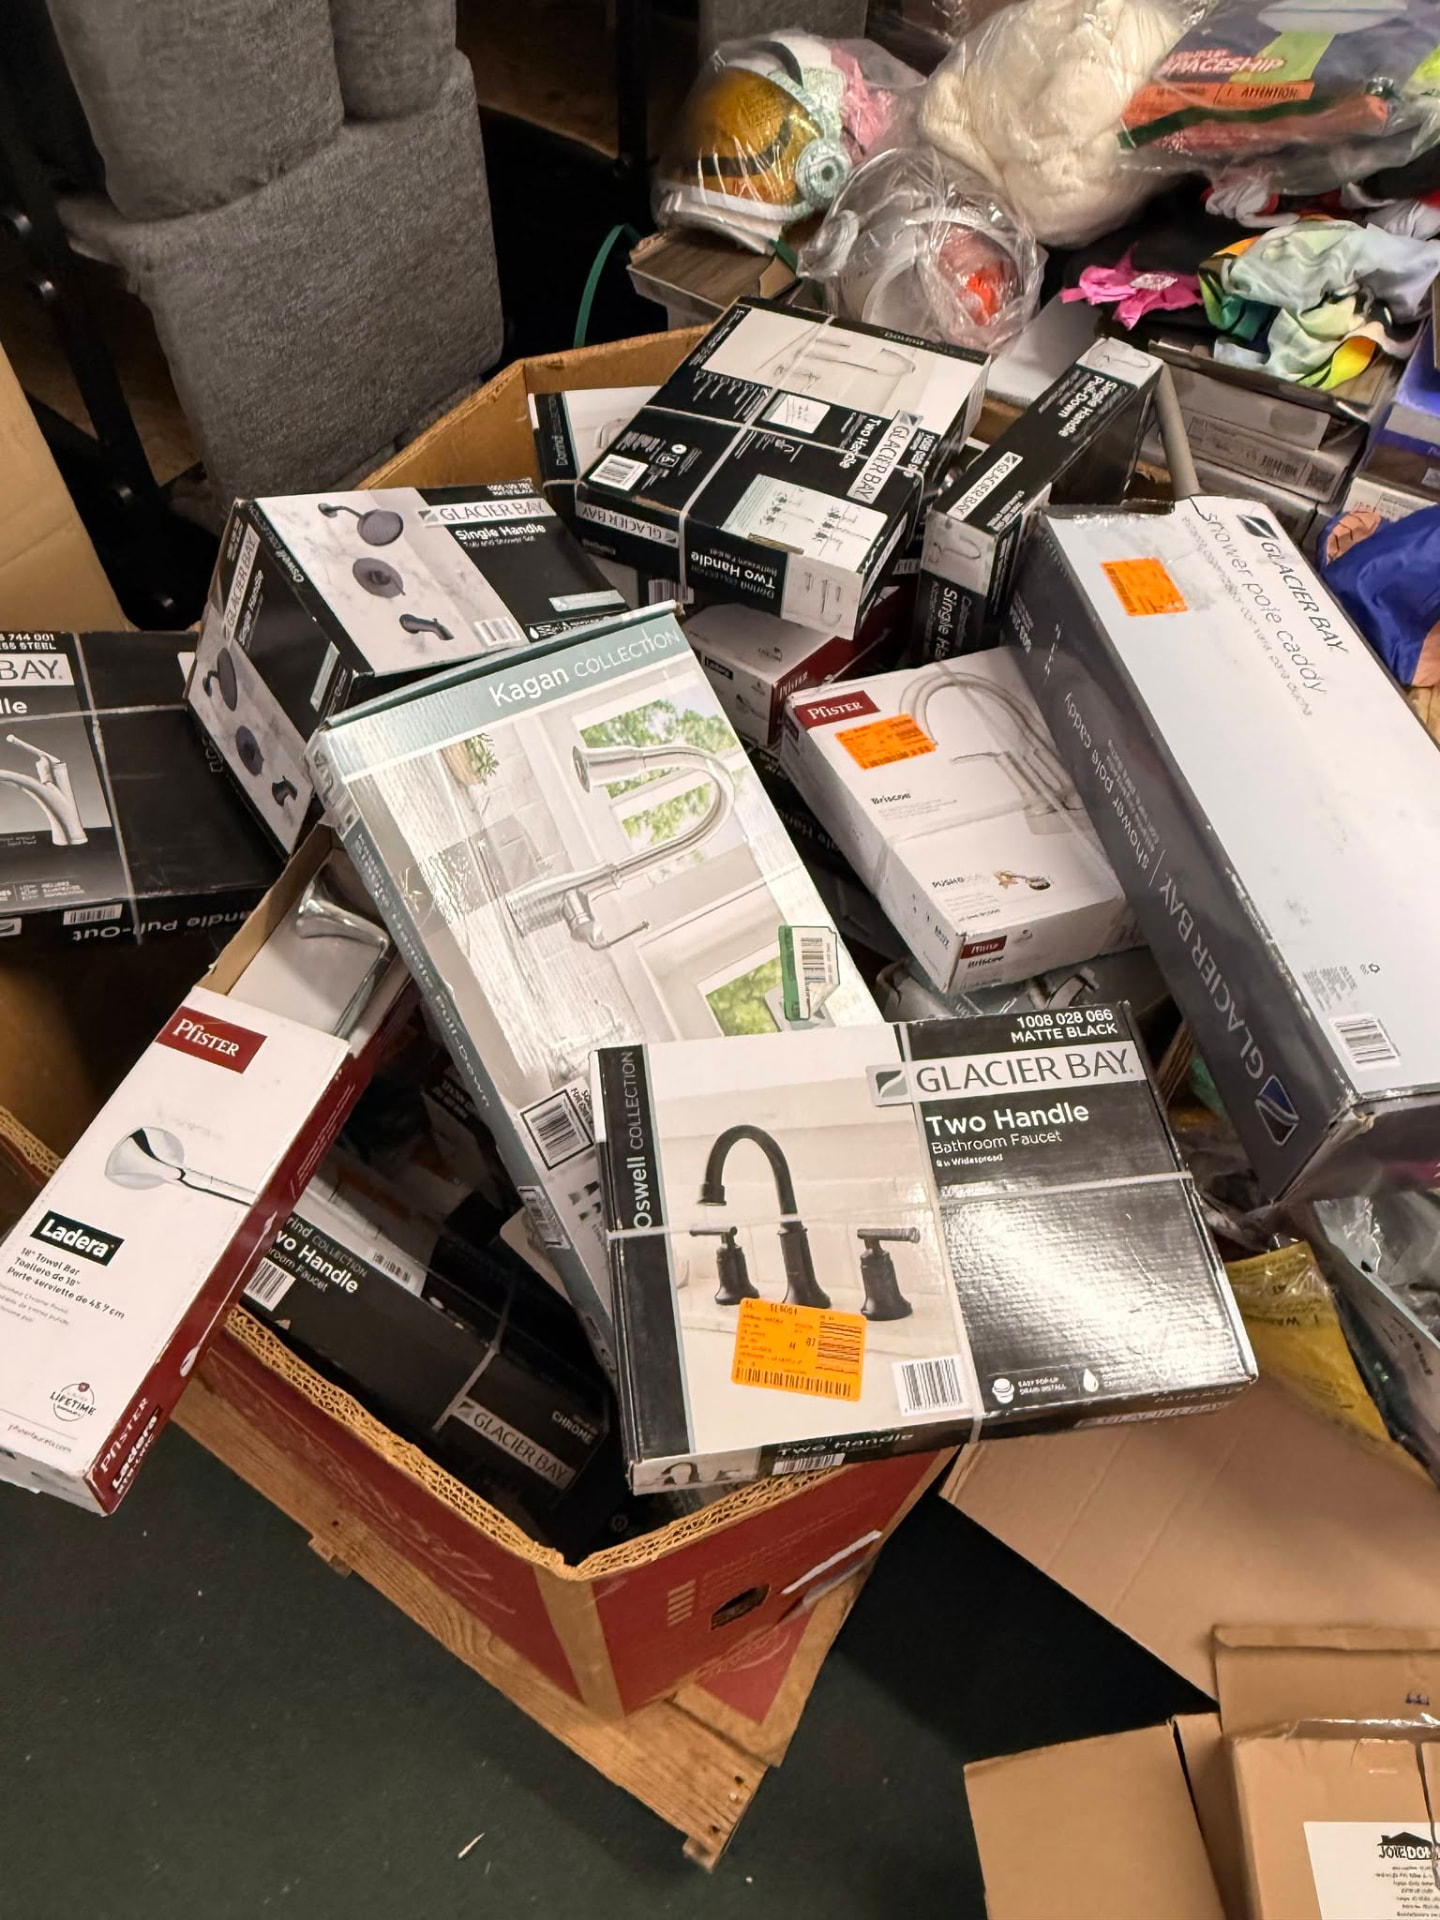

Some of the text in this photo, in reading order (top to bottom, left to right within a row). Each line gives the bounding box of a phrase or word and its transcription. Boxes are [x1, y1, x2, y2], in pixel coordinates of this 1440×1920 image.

[860, 418, 882, 436] Two
[1058, 408, 1093, 437] Handle
[869, 425, 910, 474] GLACIER
[440, 502, 544, 521] GLACIER BAY
[582, 504, 662, 539] GLACIER BAY
[455, 523, 546, 541] Single Handle
[691, 551, 776, 589] Two Handle
[1261, 542, 1320, 612] GLACIER
[938, 587, 958, 635] Single
[1203, 512, 1328, 695] shower pole caddy
[489, 626, 680, 707] Kagan COLLECTION
[1064, 692, 1150, 870] shower pole caddy
[73, 920, 178, 942] Pull-Out
[1016, 1008, 1113, 1029] 1008 028 066
[1192, 933, 1265, 1080] GLACIER
[1010, 1022, 1118, 1044] MATTE BLACK
[436, 994, 490, 1108] Pull-Down
[916, 1055, 1062, 1093] GLACIER
[925, 1101, 1089, 1136] Two Handle
[621, 1051, 652, 1229] Oswell COLLECTION
[931, 1130, 1062, 1155] Bathroom Faucet
[40, 1218, 109, 1259] Ladera
[15, 1257, 51, 1277] Toallero
[52, 1272, 64, 1282] de
[35, 1253, 65, 1271] Towel
[63, 1264, 80, 1276] Bar
[298, 1244, 359, 1293] Handle
[312, 1235, 368, 1279] COLLECTION
[296, 1264, 329, 1293] Faucet
[75, 1294, 88, 1304] de
[49, 1391, 97, 1416] LIFETIME
[552, 1410, 594, 1445] CHROME
[778, 1434, 914, 1456] Two Handle
[112, 1415, 157, 1490] Ladera
[474, 1413, 568, 1481] GLACIER BAY
